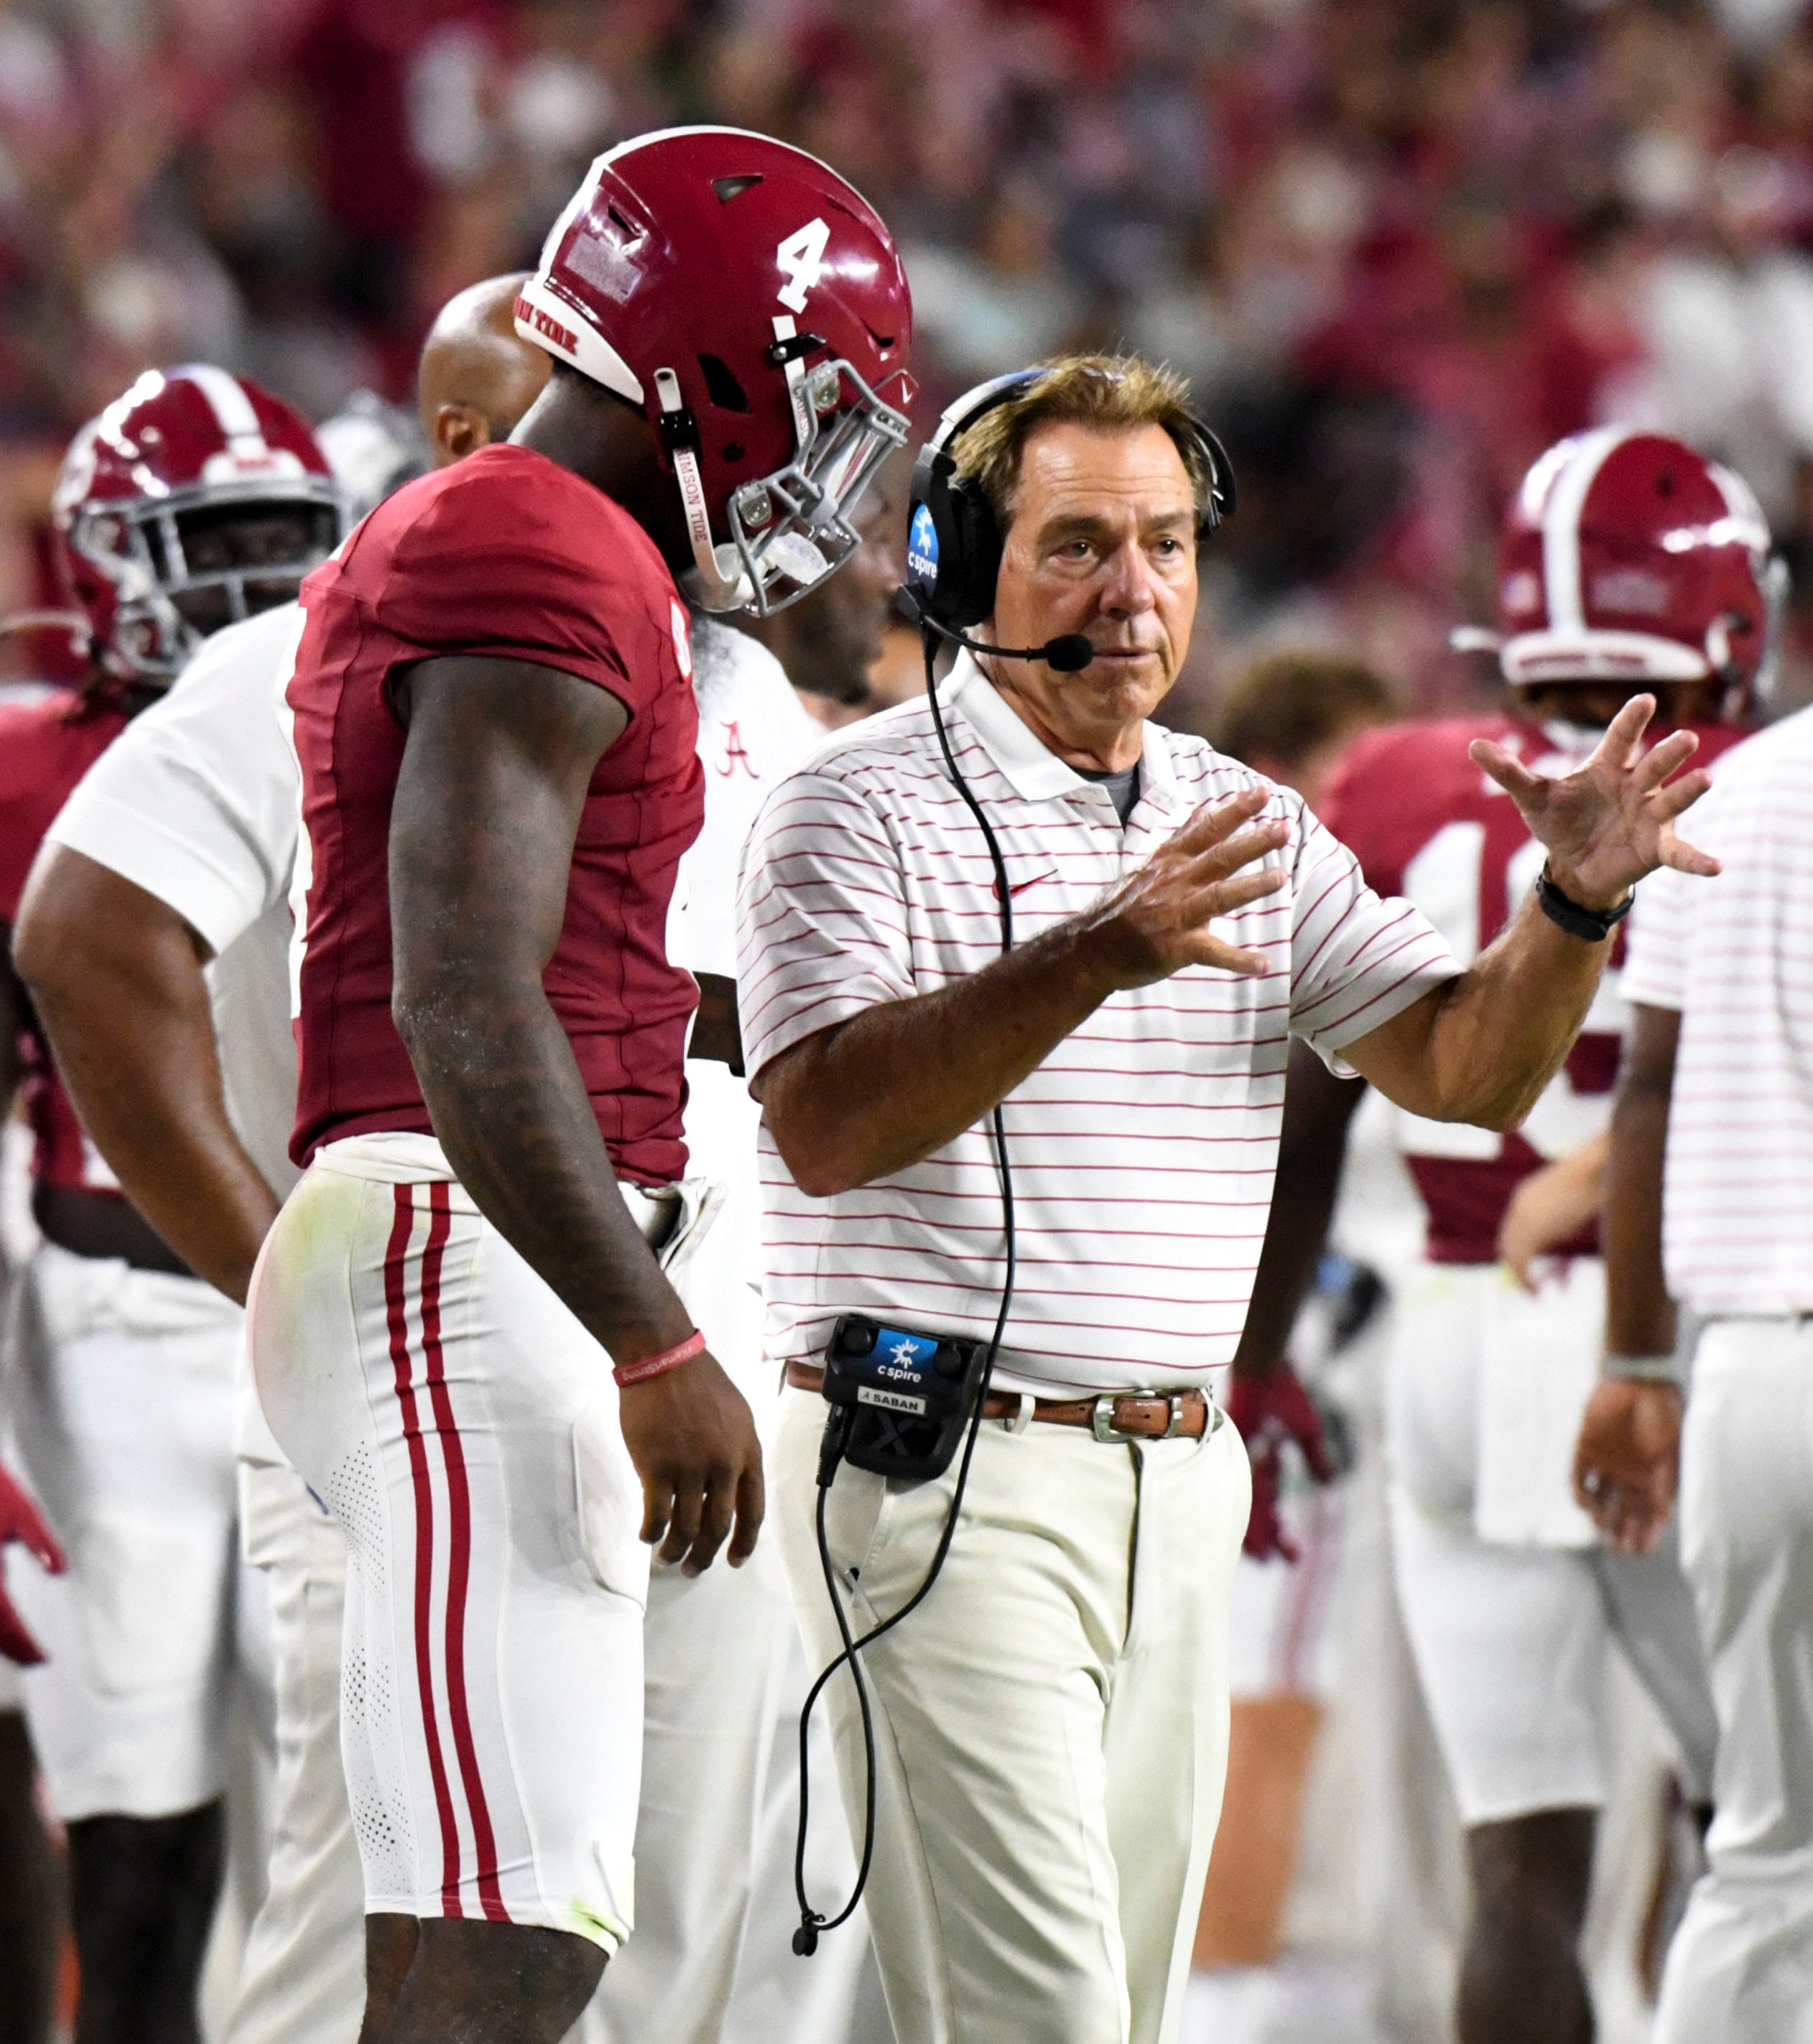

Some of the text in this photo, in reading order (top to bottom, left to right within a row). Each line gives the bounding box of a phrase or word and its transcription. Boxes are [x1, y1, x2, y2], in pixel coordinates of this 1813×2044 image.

[777, 217, 830, 314] 4
[534, 309, 578, 356] TIDE
[794, 386, 810, 439] CRIMSO
[690, 510, 707, 542] TIDE
[914, 554, 937, 579] spire
[714, 720, 764, 781] A
[886, 1366, 922, 1383] spire
[873, 1394, 918, 1410] SABAN
